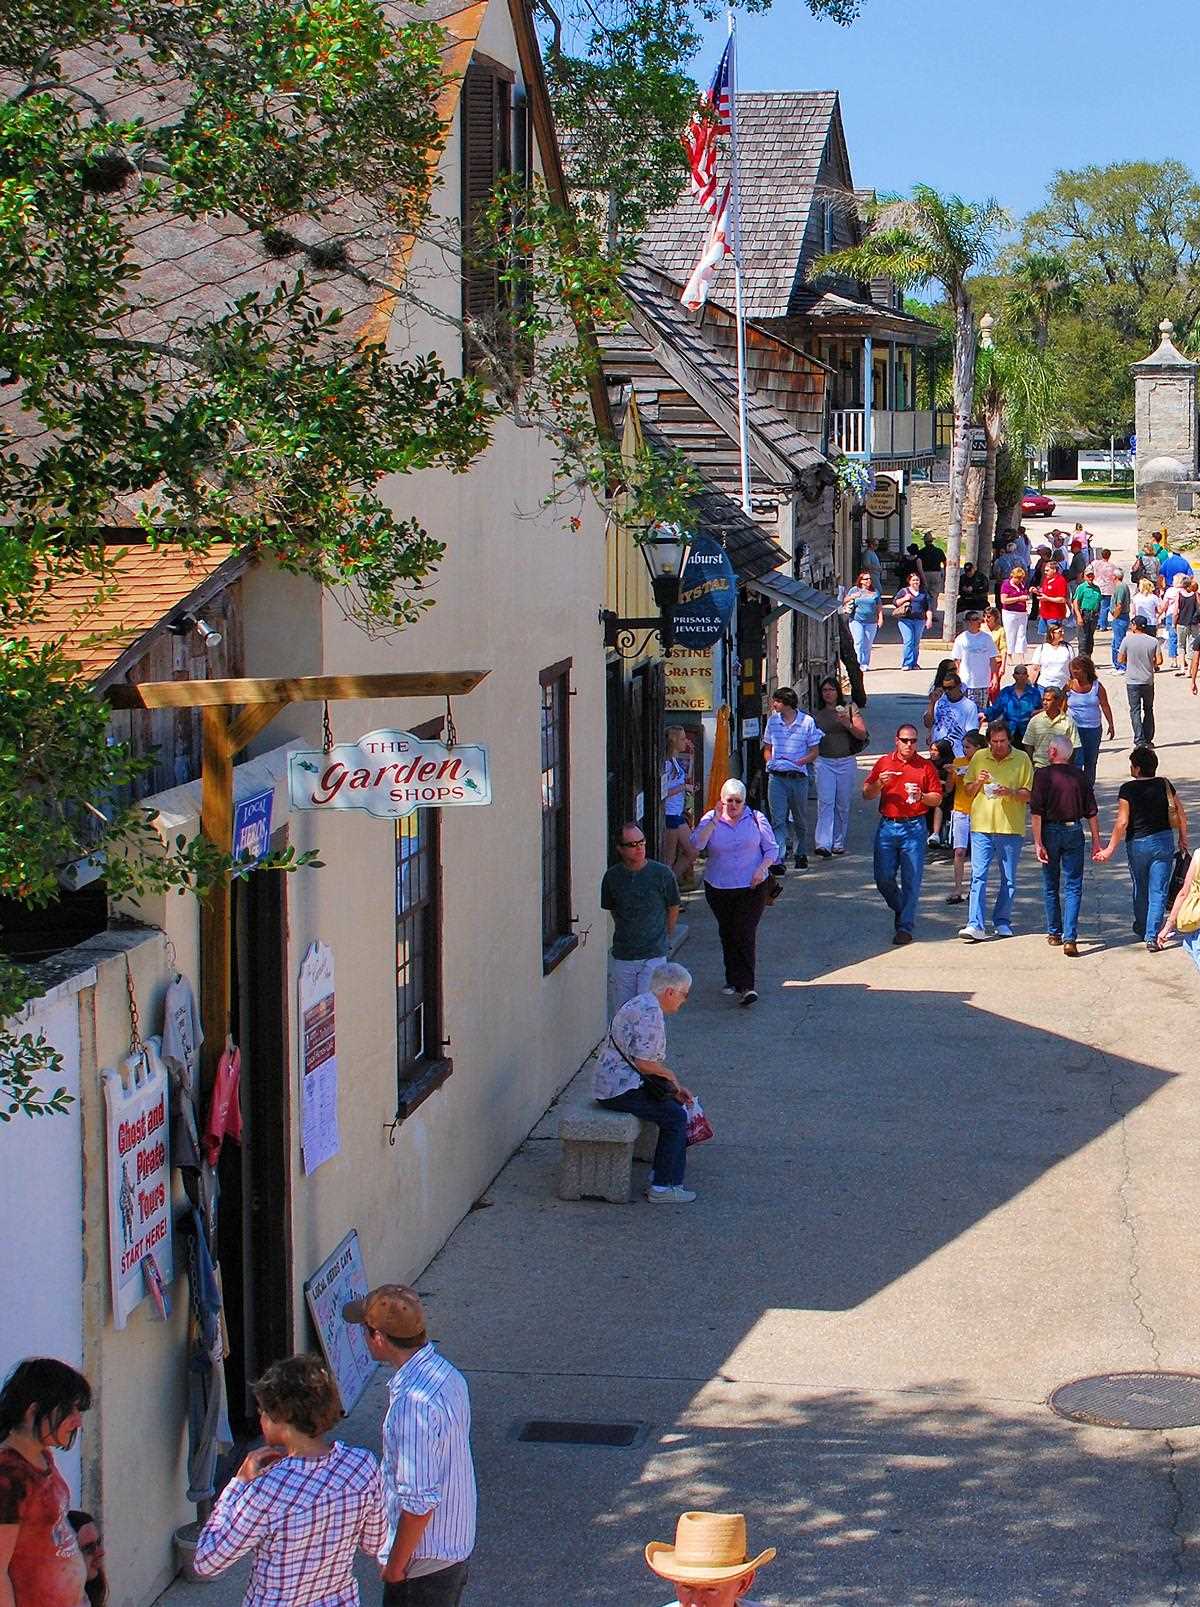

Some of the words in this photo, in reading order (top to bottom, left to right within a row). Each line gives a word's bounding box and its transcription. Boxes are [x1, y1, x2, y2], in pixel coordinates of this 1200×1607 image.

[687, 551, 724, 565] nburst
[673, 616, 711, 624] PRISMS
[713, 616, 721, 624] &
[675, 625, 720, 633] JEWELRY
[366, 741, 409, 754] THE
[389, 786, 464, 802] SHOPS
[118, 1112, 146, 1157] Ghost
[146, 1093, 165, 1137] and
[136, 1141, 166, 1185] Pirate
[138, 1181, 166, 1224] Tours
[121, 1237, 145, 1274] START
[145, 1215, 168, 1252] HERE!
